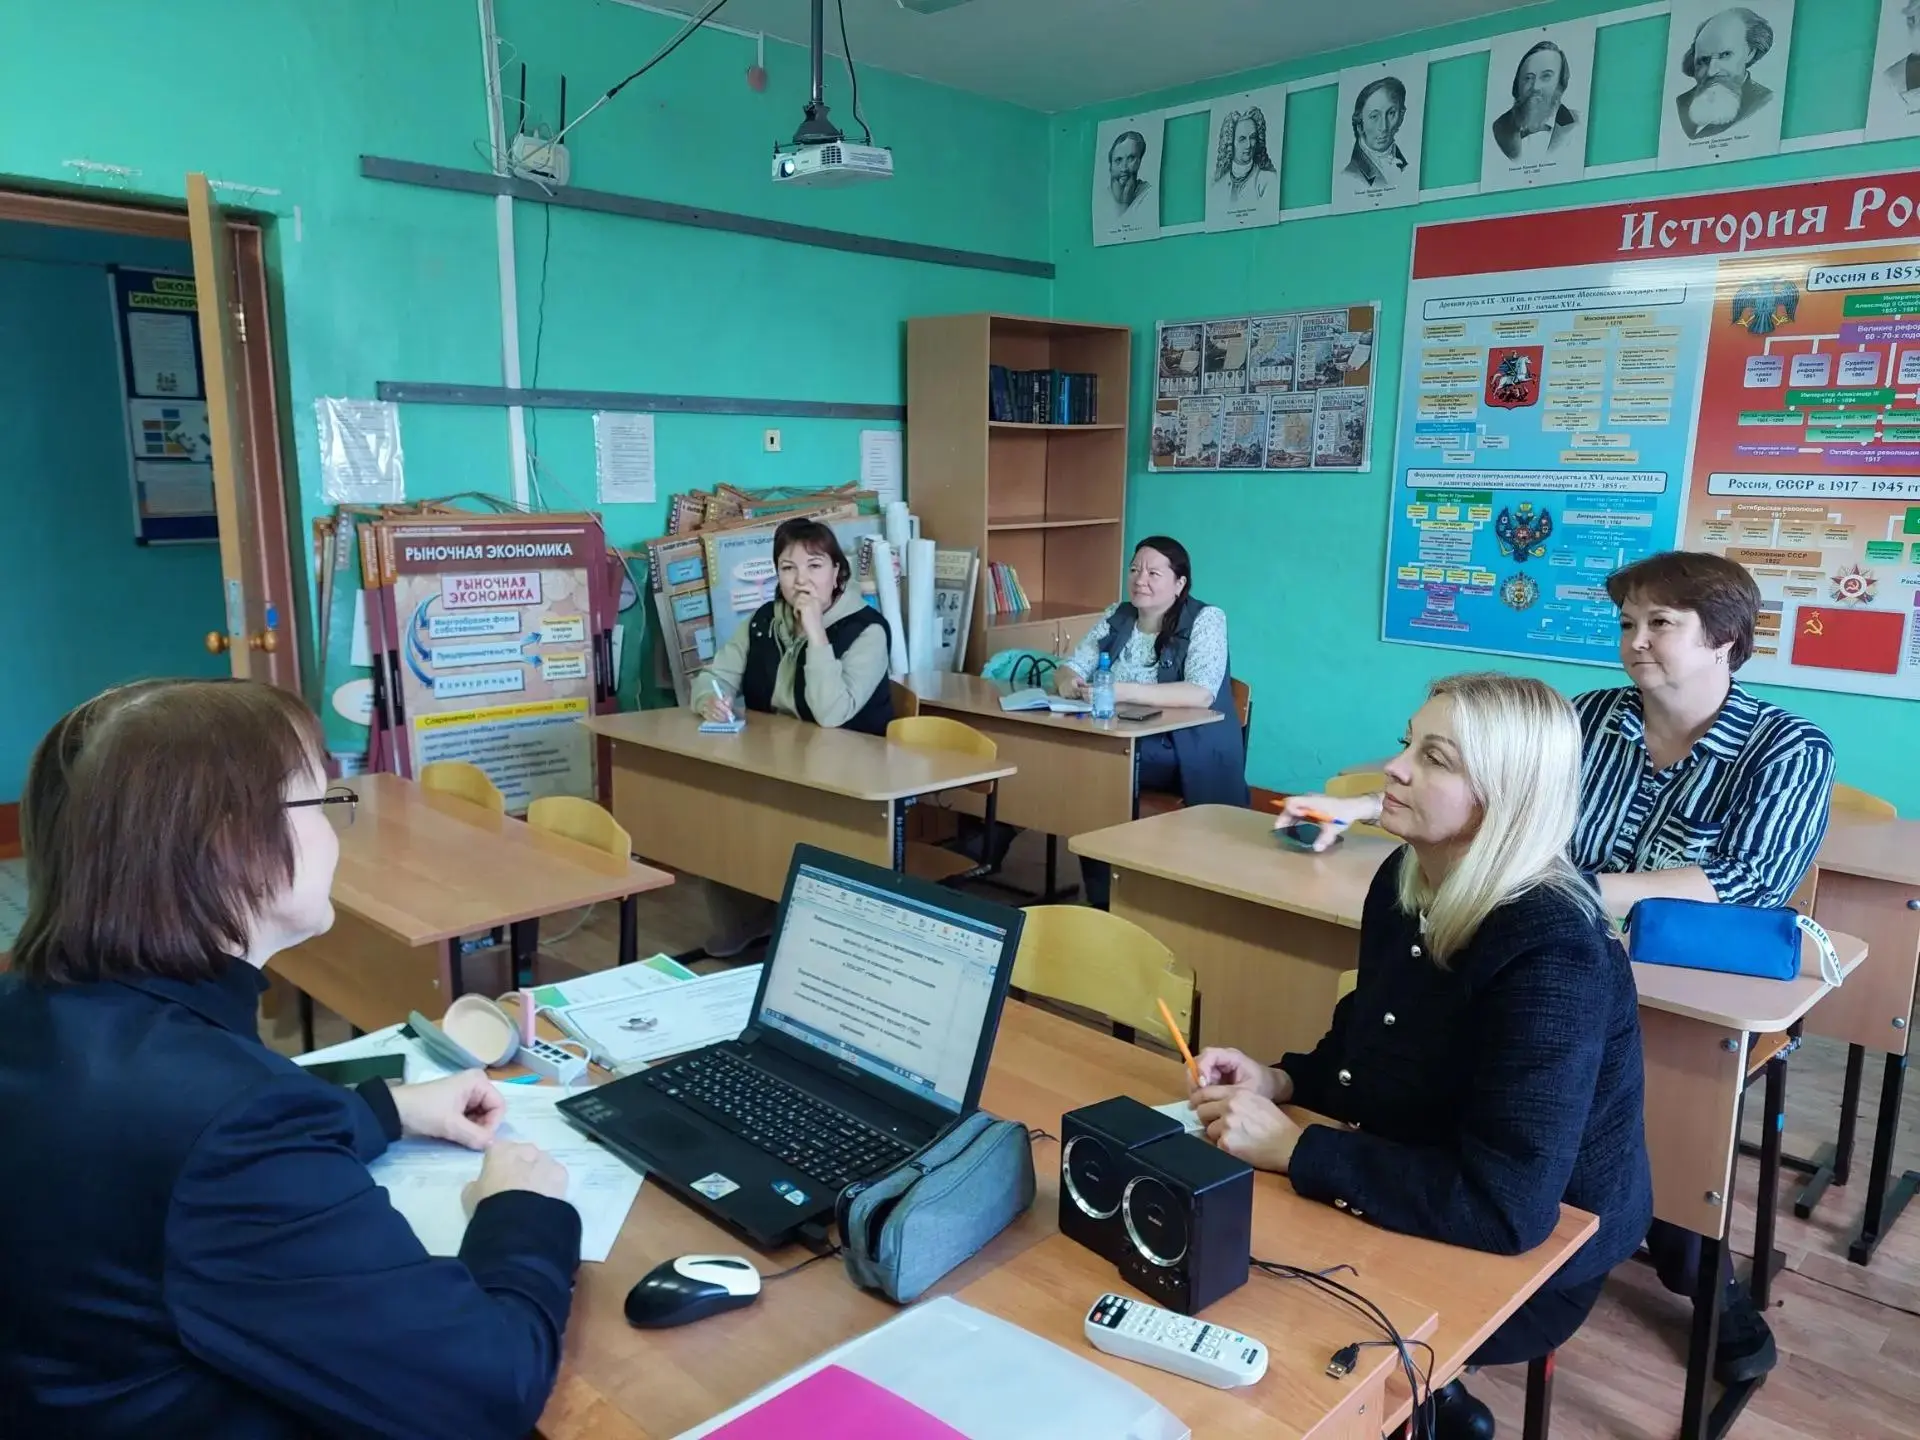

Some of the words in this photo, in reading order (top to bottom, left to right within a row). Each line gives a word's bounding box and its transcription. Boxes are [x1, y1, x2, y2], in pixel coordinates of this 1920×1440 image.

[1617, 206, 1828, 252] История
[1844, 187, 1920, 231] Ро
[1814, 271, 1866, 284] Россия
[1886, 266, 1920, 280] 1855
[156, 281, 195, 292] ШКОЛ
[132, 294, 196, 308] САМОУПР
[1561, 301, 1577, 309] XVI
[1830, 448, 1875, 456] Октябрьская
[1728, 478, 1772, 491] Россия,
[1776, 479, 1815, 491] СССР
[1818, 482, 1825, 490] в
[1830, 481, 1859, 492] 1917
[1872, 481, 1904, 493] 1945
[1738, 504, 1781, 512] Октябрьская
[405, 545, 483, 562] РЫНОЧНАЯ
[487, 542, 574, 560] ЭКОНОМИКА
[1740, 550, 1786, 558] Образование
[456, 577, 527, 590] РЫНОЧНАЯ
[450, 591, 535, 604] ЭКОНОМИКА
[1801, 918, 1829, 945] BLUE
